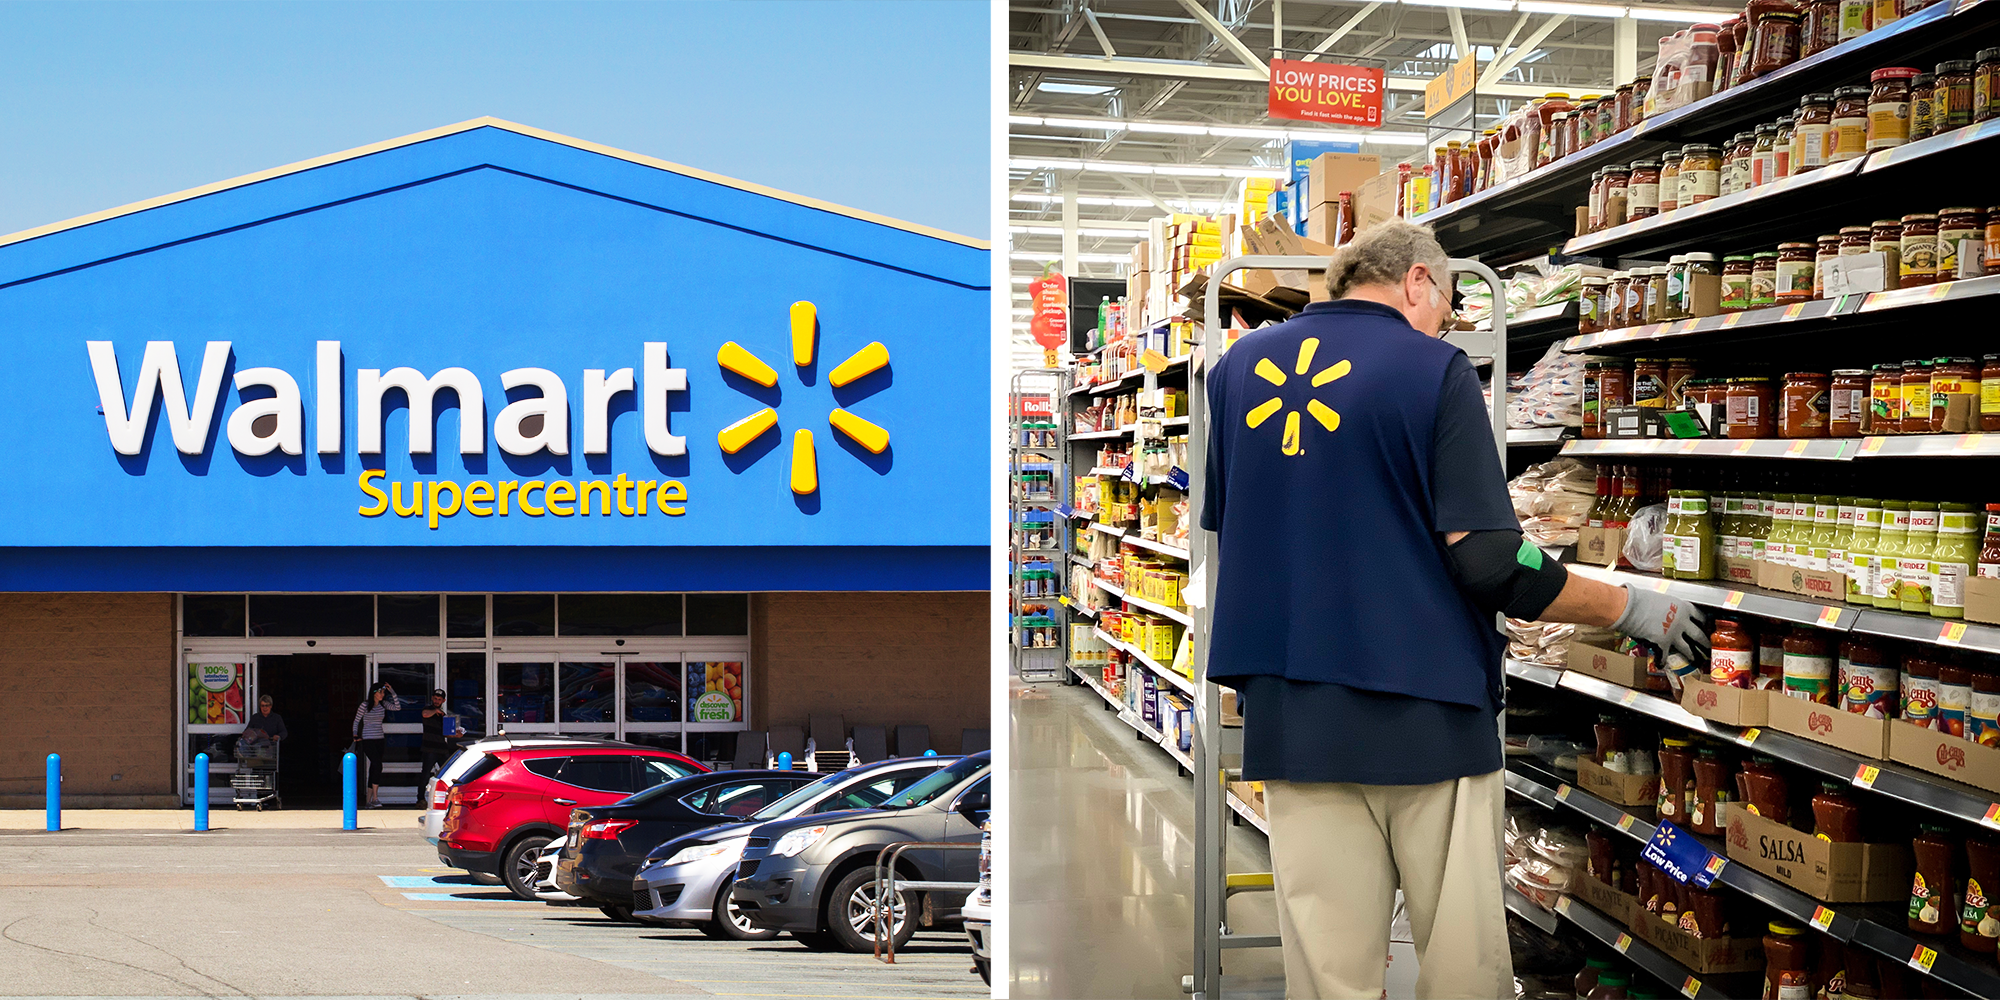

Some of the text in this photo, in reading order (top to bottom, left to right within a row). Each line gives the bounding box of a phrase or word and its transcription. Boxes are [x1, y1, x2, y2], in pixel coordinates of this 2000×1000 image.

[1276, 70, 1376, 93] LOW PRICES
[1461, 66, 1472, 89] A15
[1274, 86, 1366, 108] YOU LOVE.
[1429, 90, 1440, 110] A14
[1047, 355, 1056, 364] 13
[1936, 382, 1962, 392] GOLD
[86, 340, 687, 455] Walmart
[358, 469, 687, 528] Supercentre
[1730, 567, 1752, 579] HERDEZ
[1805, 578, 1833, 592] HERDEZ
[1662, 603, 1678, 634] ACE
[204, 666, 229, 674] 100%
[1714, 658, 1735, 673] CHI'S
[1852, 676, 1874, 693] CHI'S
[1911, 688, 1936, 708] CHI'S
[700, 709, 730, 720] fresh
[1760, 835, 1805, 865] SALSA
[1645, 847, 1666, 866] Low
[1664, 860, 1687, 882] Price
[1776, 865, 1792, 879] MILD
[1655, 926, 1689, 949] PICANTE
